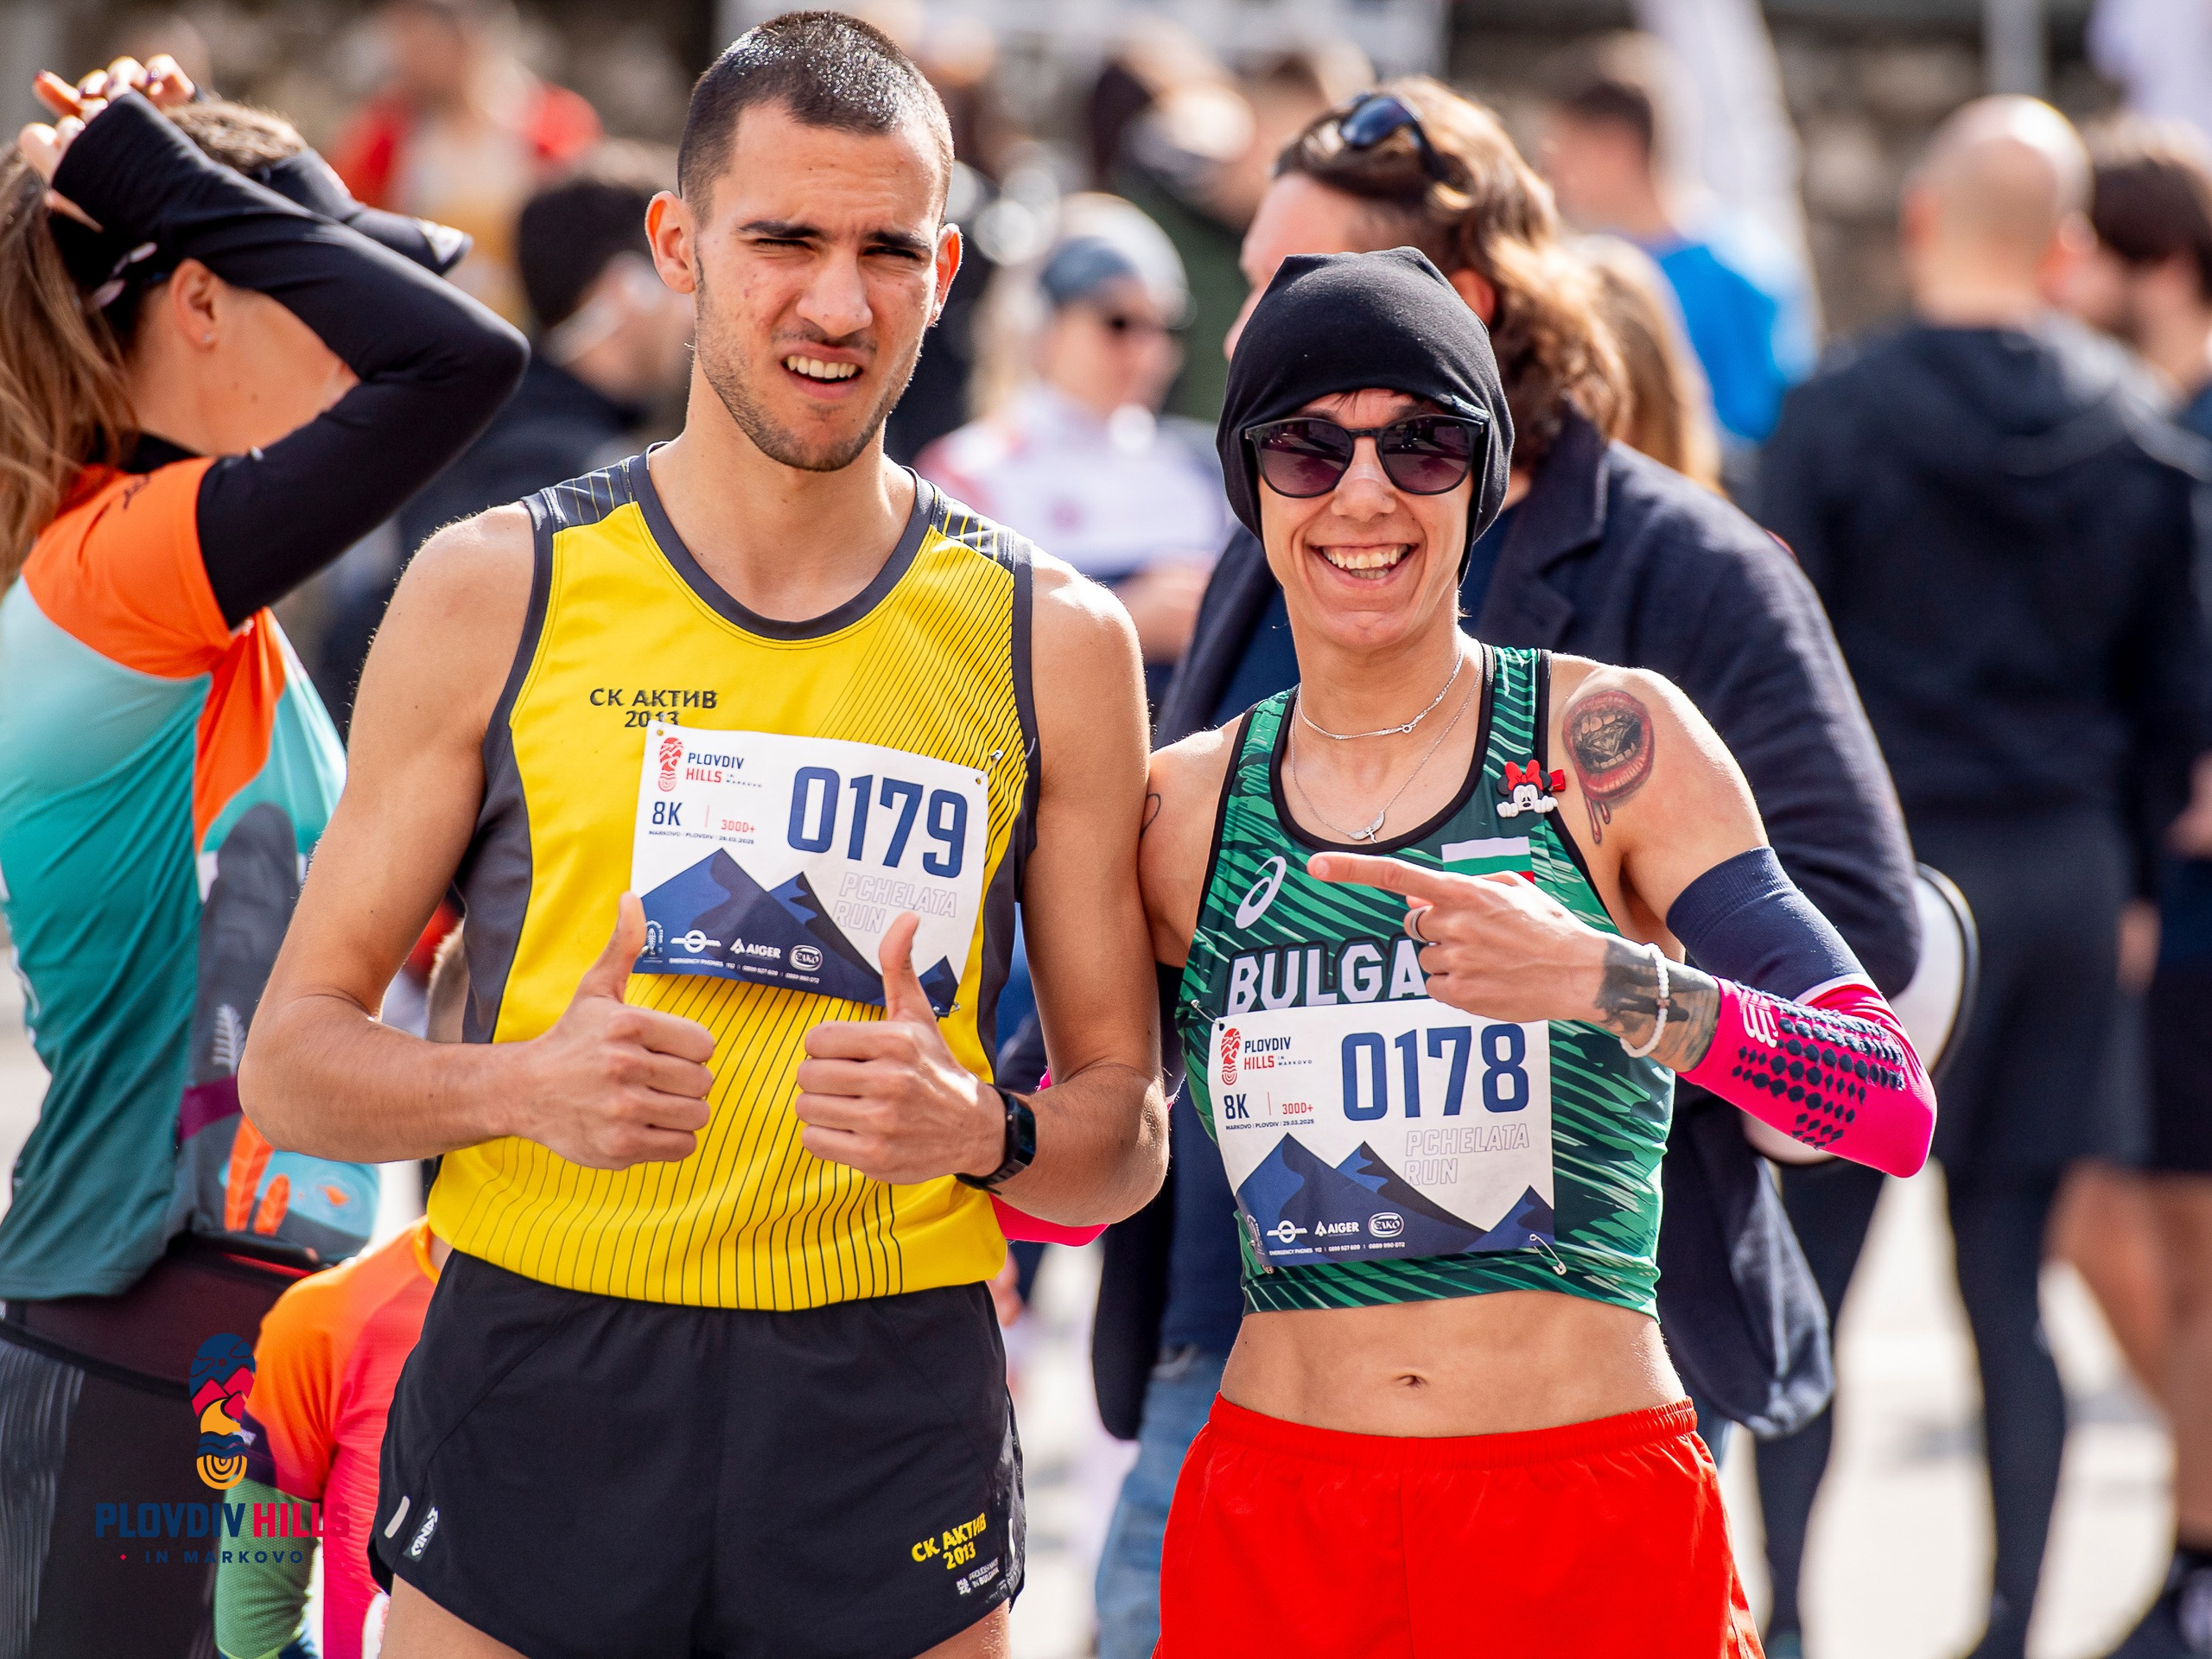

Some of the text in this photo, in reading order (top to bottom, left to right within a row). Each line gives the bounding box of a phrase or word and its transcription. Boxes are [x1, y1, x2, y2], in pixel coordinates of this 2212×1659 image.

[589, 689, 718, 709] СК АКТИВ
[688, 752, 745, 770] PLOVDIV
[685, 767, 723, 784] HILLS
[652, 801, 683, 826] 8K
[787, 766, 969, 879] 0179
[839, 871, 958, 918] PCHELATA
[832, 899, 887, 934] RUN
[746, 943, 782, 960] AIGER
[1227, 938, 1428, 1017] BULGA
[1244, 1036, 1292, 1054] PLOVDIV
[1243, 1055, 1274, 1071] HILLS
[1341, 1023, 1530, 1122] 0178
[1224, 1093, 1250, 1120] 8K
[1405, 1122, 1530, 1157] PCHELATA
[1404, 1158, 1459, 1186] RUN
[1327, 1221, 1360, 1235] AIGER
[912, 1512, 987, 1562] СК АКТИВ
[943, 1541, 976, 1570] 2013
